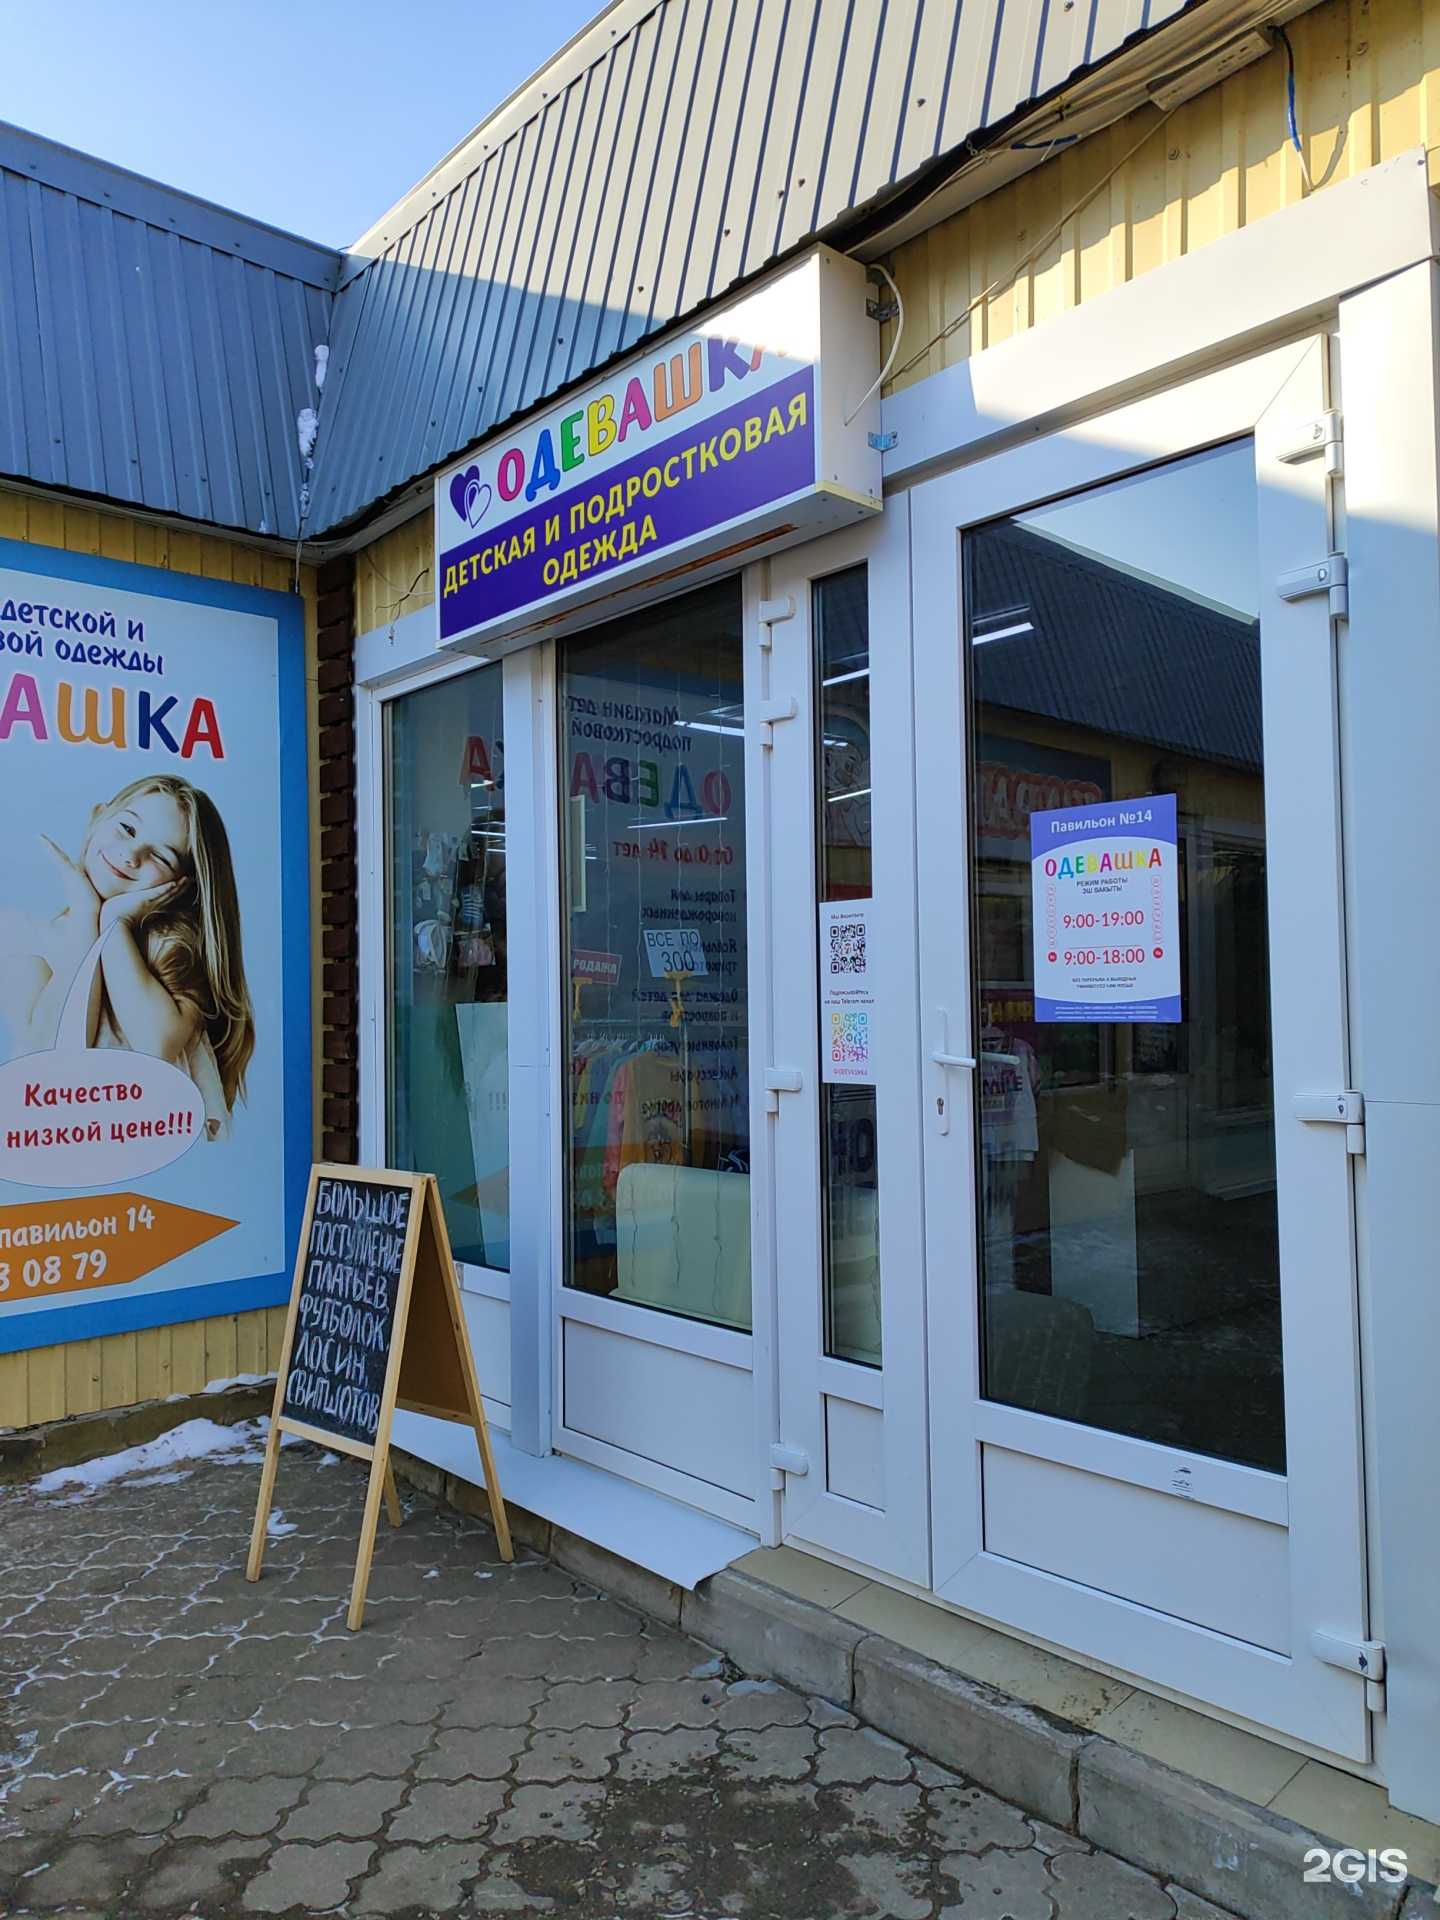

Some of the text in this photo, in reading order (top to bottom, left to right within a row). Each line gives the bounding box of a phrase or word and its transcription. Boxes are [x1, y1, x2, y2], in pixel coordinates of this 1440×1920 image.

[443, 392, 808, 598] ДЕТСКАЯ И ПОДРОСТКОВАЯ
[543, 514, 657, 586] ОДЕЖДА
[1, 599, 145, 642] детской и
[55, 638, 163, 675] одежды
[0, 673, 224, 759] АШКА
[1051, 809, 1153, 834] Павильон №14
[1045, 848, 1162, 880] ОДЕВАШКА
[1063, 910, 1144, 929] 9:00-19:00
[646, 931, 700, 948] ВСЕ ПО
[1064, 948, 1145, 967] 9:00-18:00
[661, 950, 695, 972] 300
[24, 1083, 143, 1107] Качество
[6, 1111, 193, 1148] низкой цене!!!
[316, 1180, 410, 1228] БОЛЬШОЕ
[0, 1204, 155, 1249] павильон 14
[309, 1220, 405, 1274] ПОСТУПЛЕНИЕ
[22, 1255, 61, 1287] 08
[72, 1249, 107, 1280] 79
